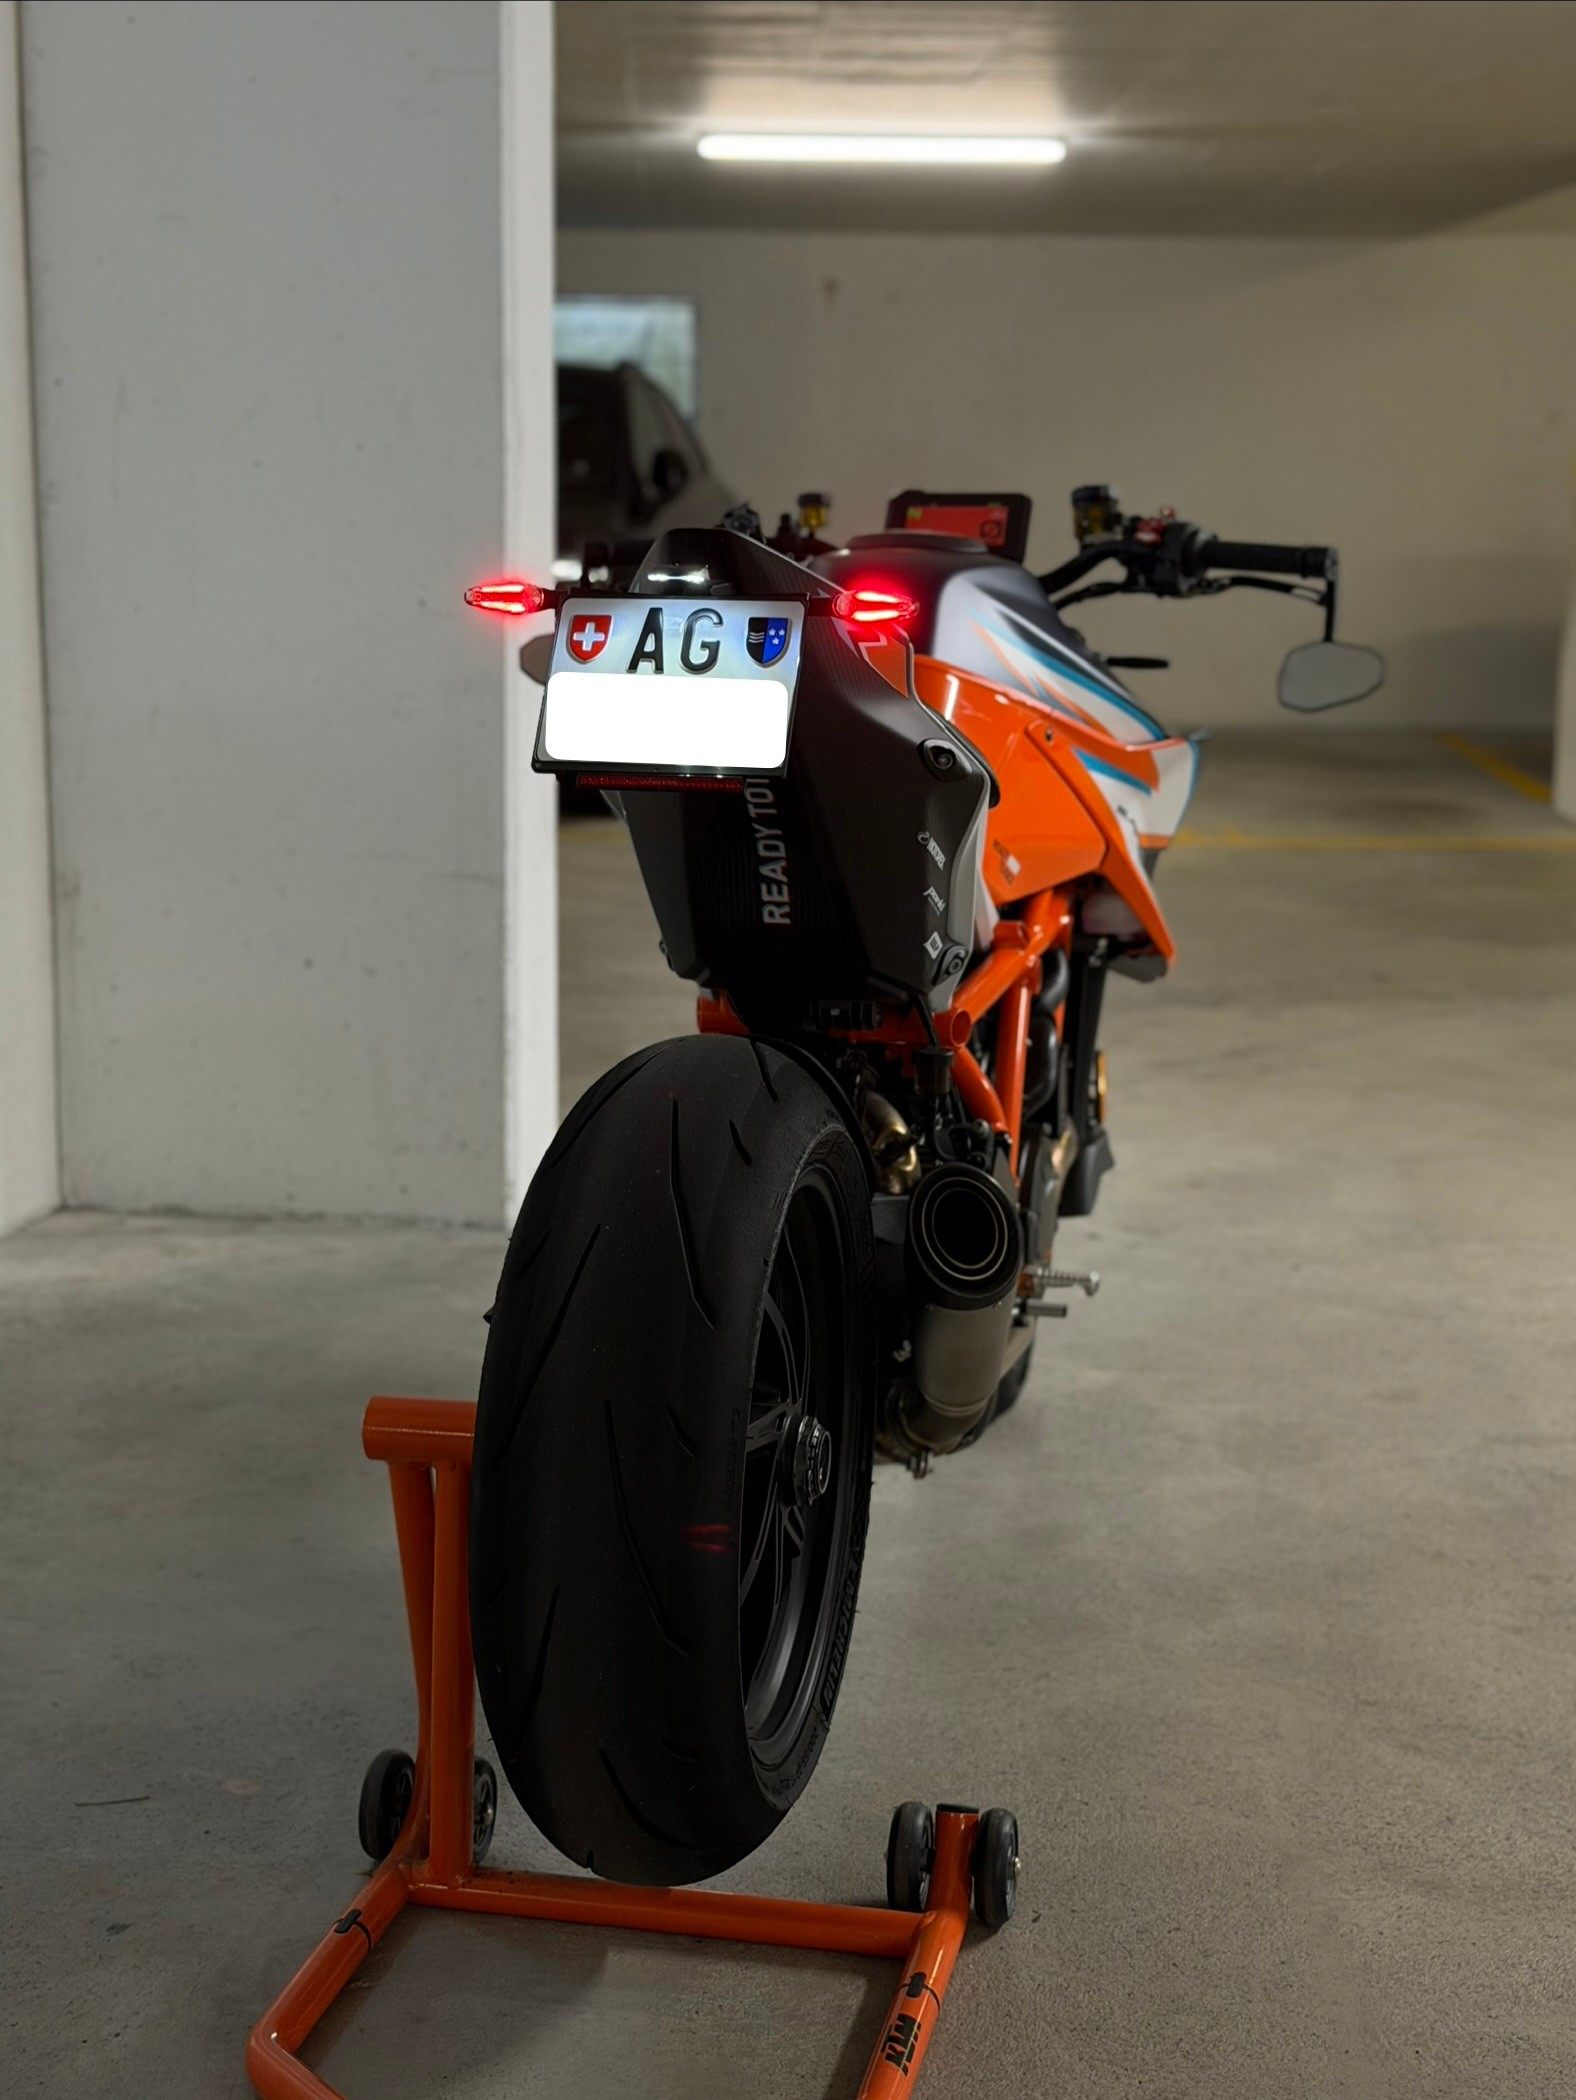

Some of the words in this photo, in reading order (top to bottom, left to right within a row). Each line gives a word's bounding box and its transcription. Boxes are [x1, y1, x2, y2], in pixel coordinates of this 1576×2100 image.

[627, 607, 724, 674] AG
[752, 822, 791, 925] READY
[823, 1578, 855, 1707] MICHELIN
[881, 2013, 922, 2077] KTM
